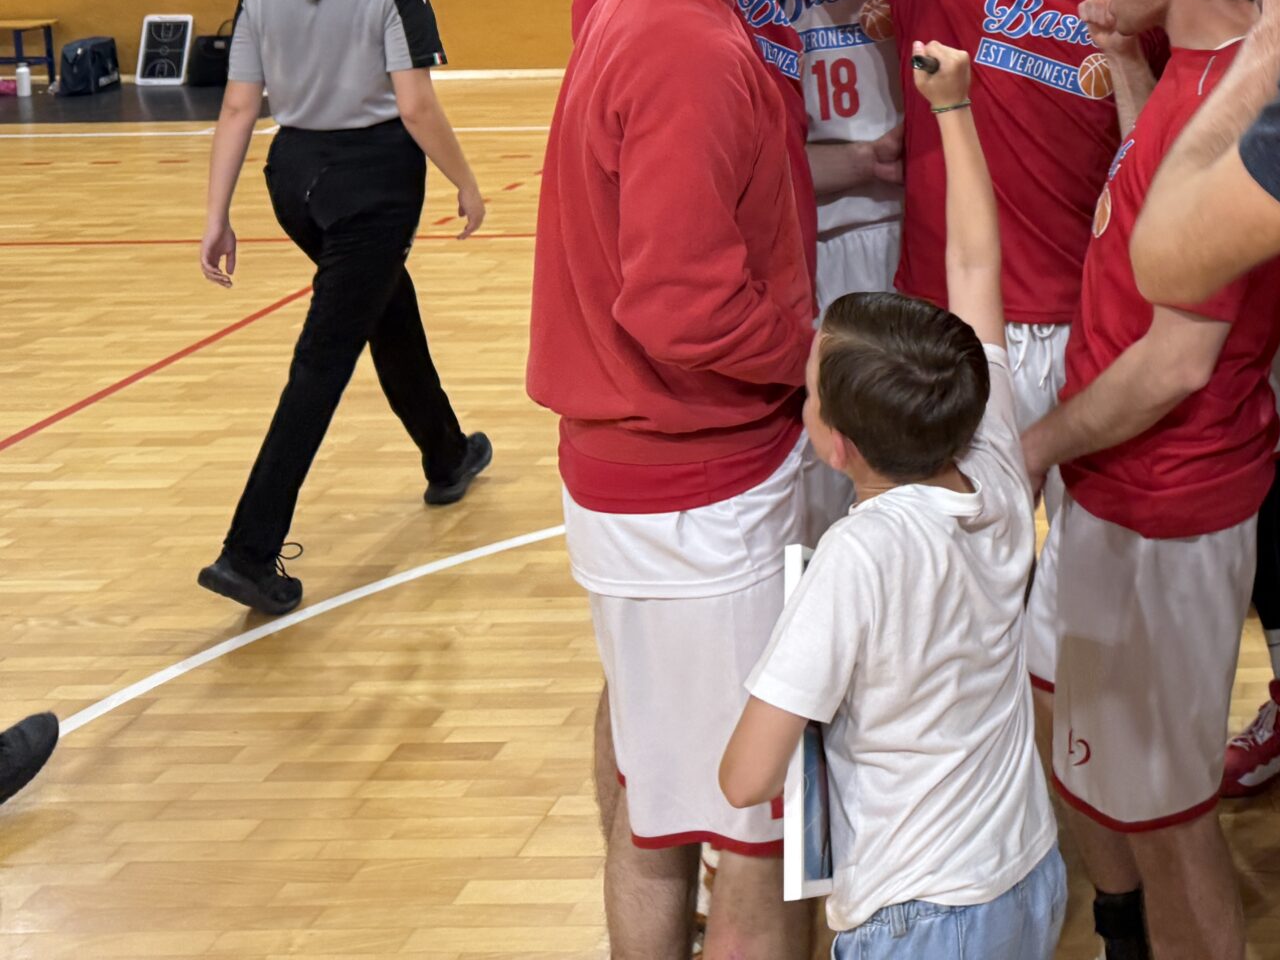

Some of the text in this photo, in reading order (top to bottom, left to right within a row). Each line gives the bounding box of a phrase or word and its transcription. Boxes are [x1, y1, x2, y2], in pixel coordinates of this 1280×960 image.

[811, 58, 860, 121] 18
[979, 43, 1078, 89] EST VERONESE
